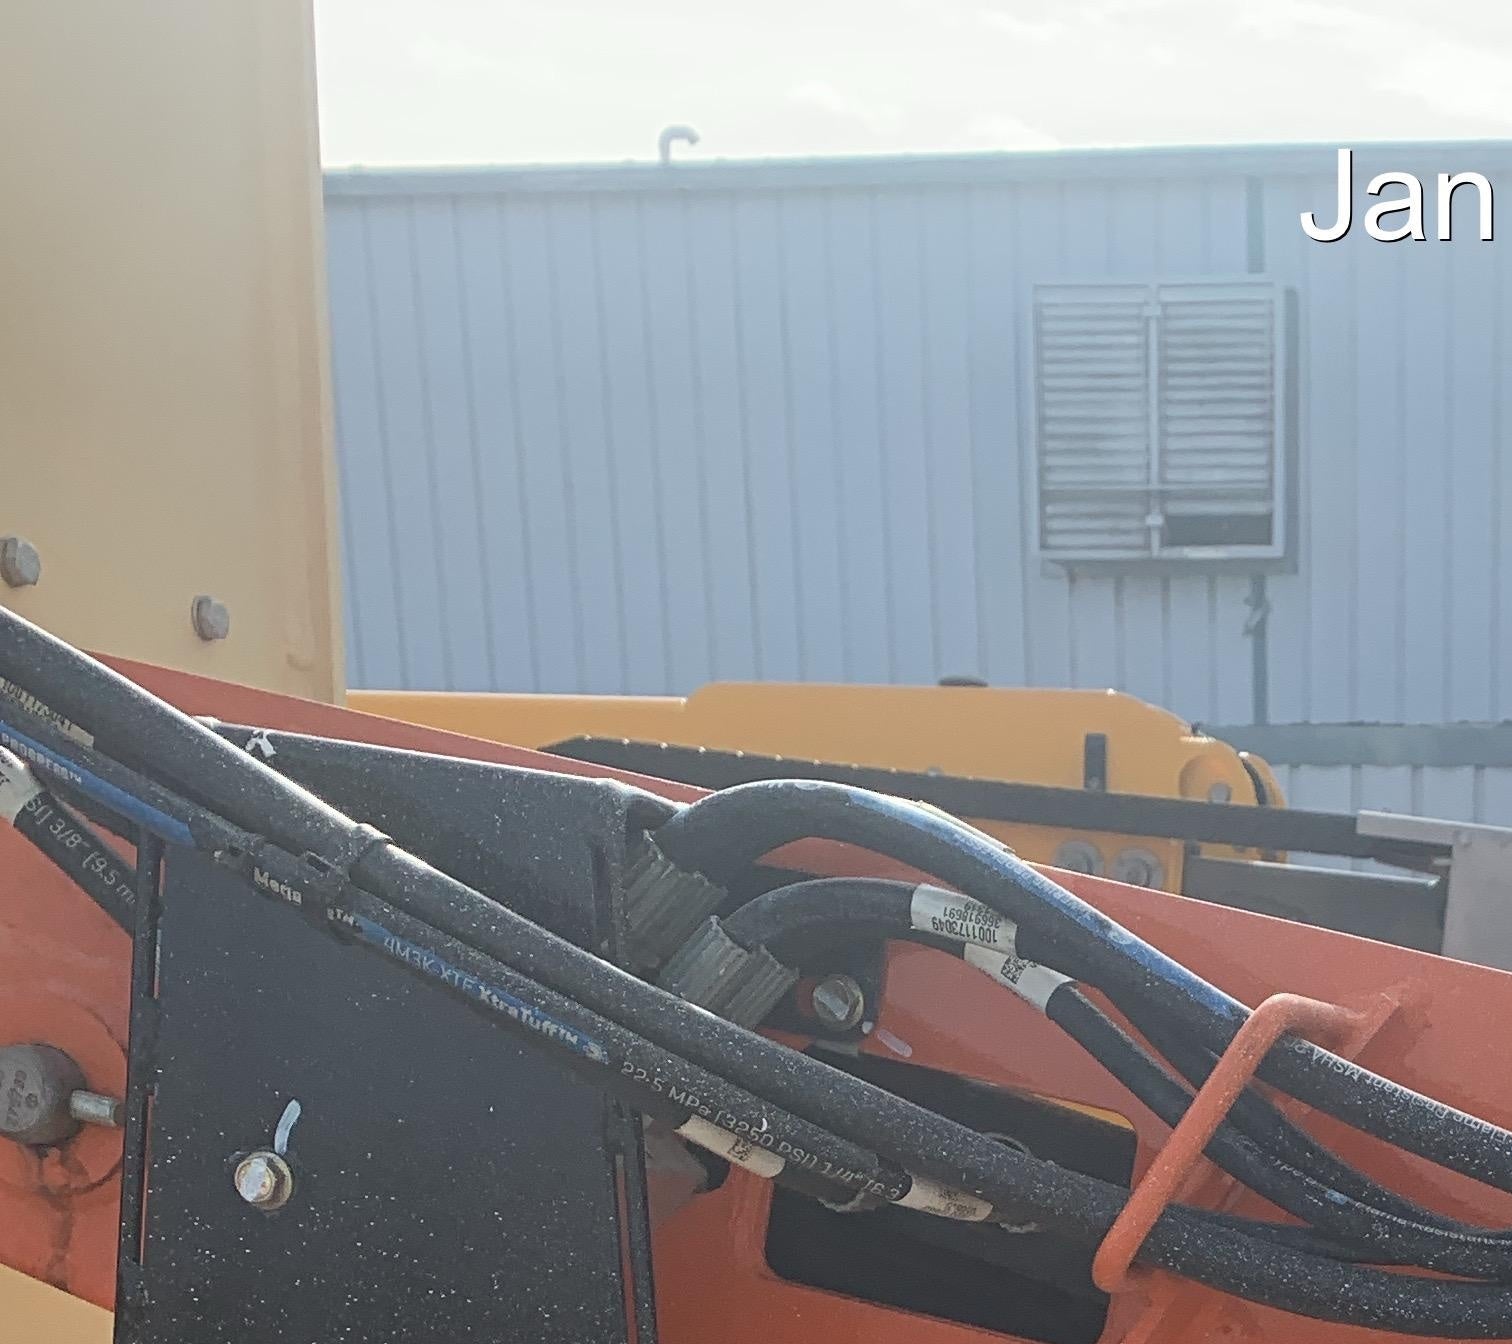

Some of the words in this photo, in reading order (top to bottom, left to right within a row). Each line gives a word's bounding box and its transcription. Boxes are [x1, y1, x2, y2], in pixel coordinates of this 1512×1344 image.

[932, 917, 997, 943] 1001173049
[1309, 1044, 1364, 1082] MSHA
[666, 1084, 713, 1118] MPa
